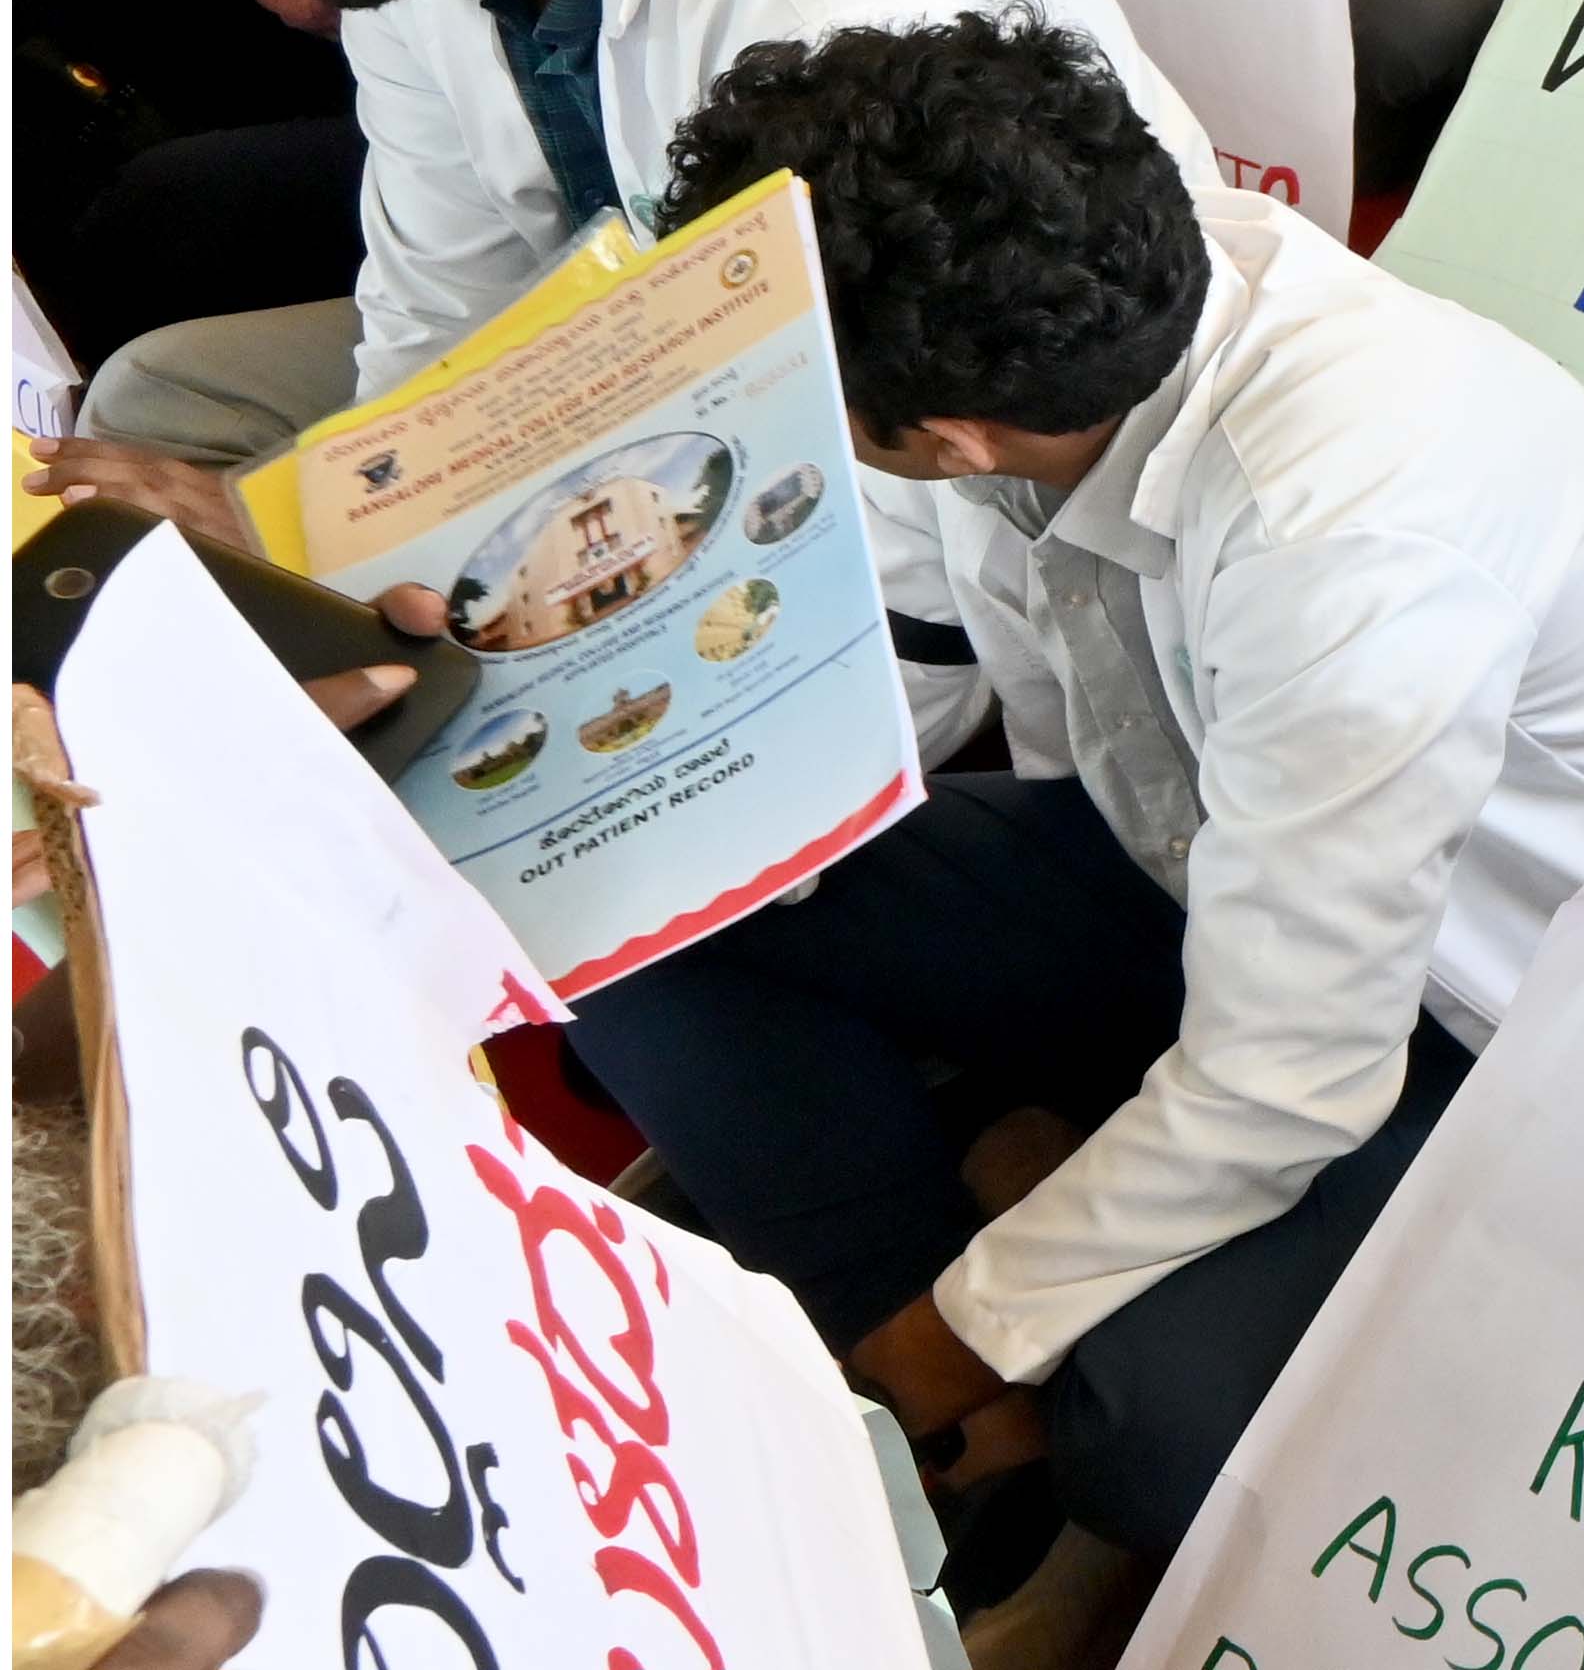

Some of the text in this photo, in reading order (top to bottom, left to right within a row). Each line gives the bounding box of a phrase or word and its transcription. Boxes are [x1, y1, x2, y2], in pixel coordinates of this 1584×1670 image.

[519, 851, 567, 884] OUT
[573, 802, 662, 859] PATIENT
[668, 753, 756, 809] RECORD
